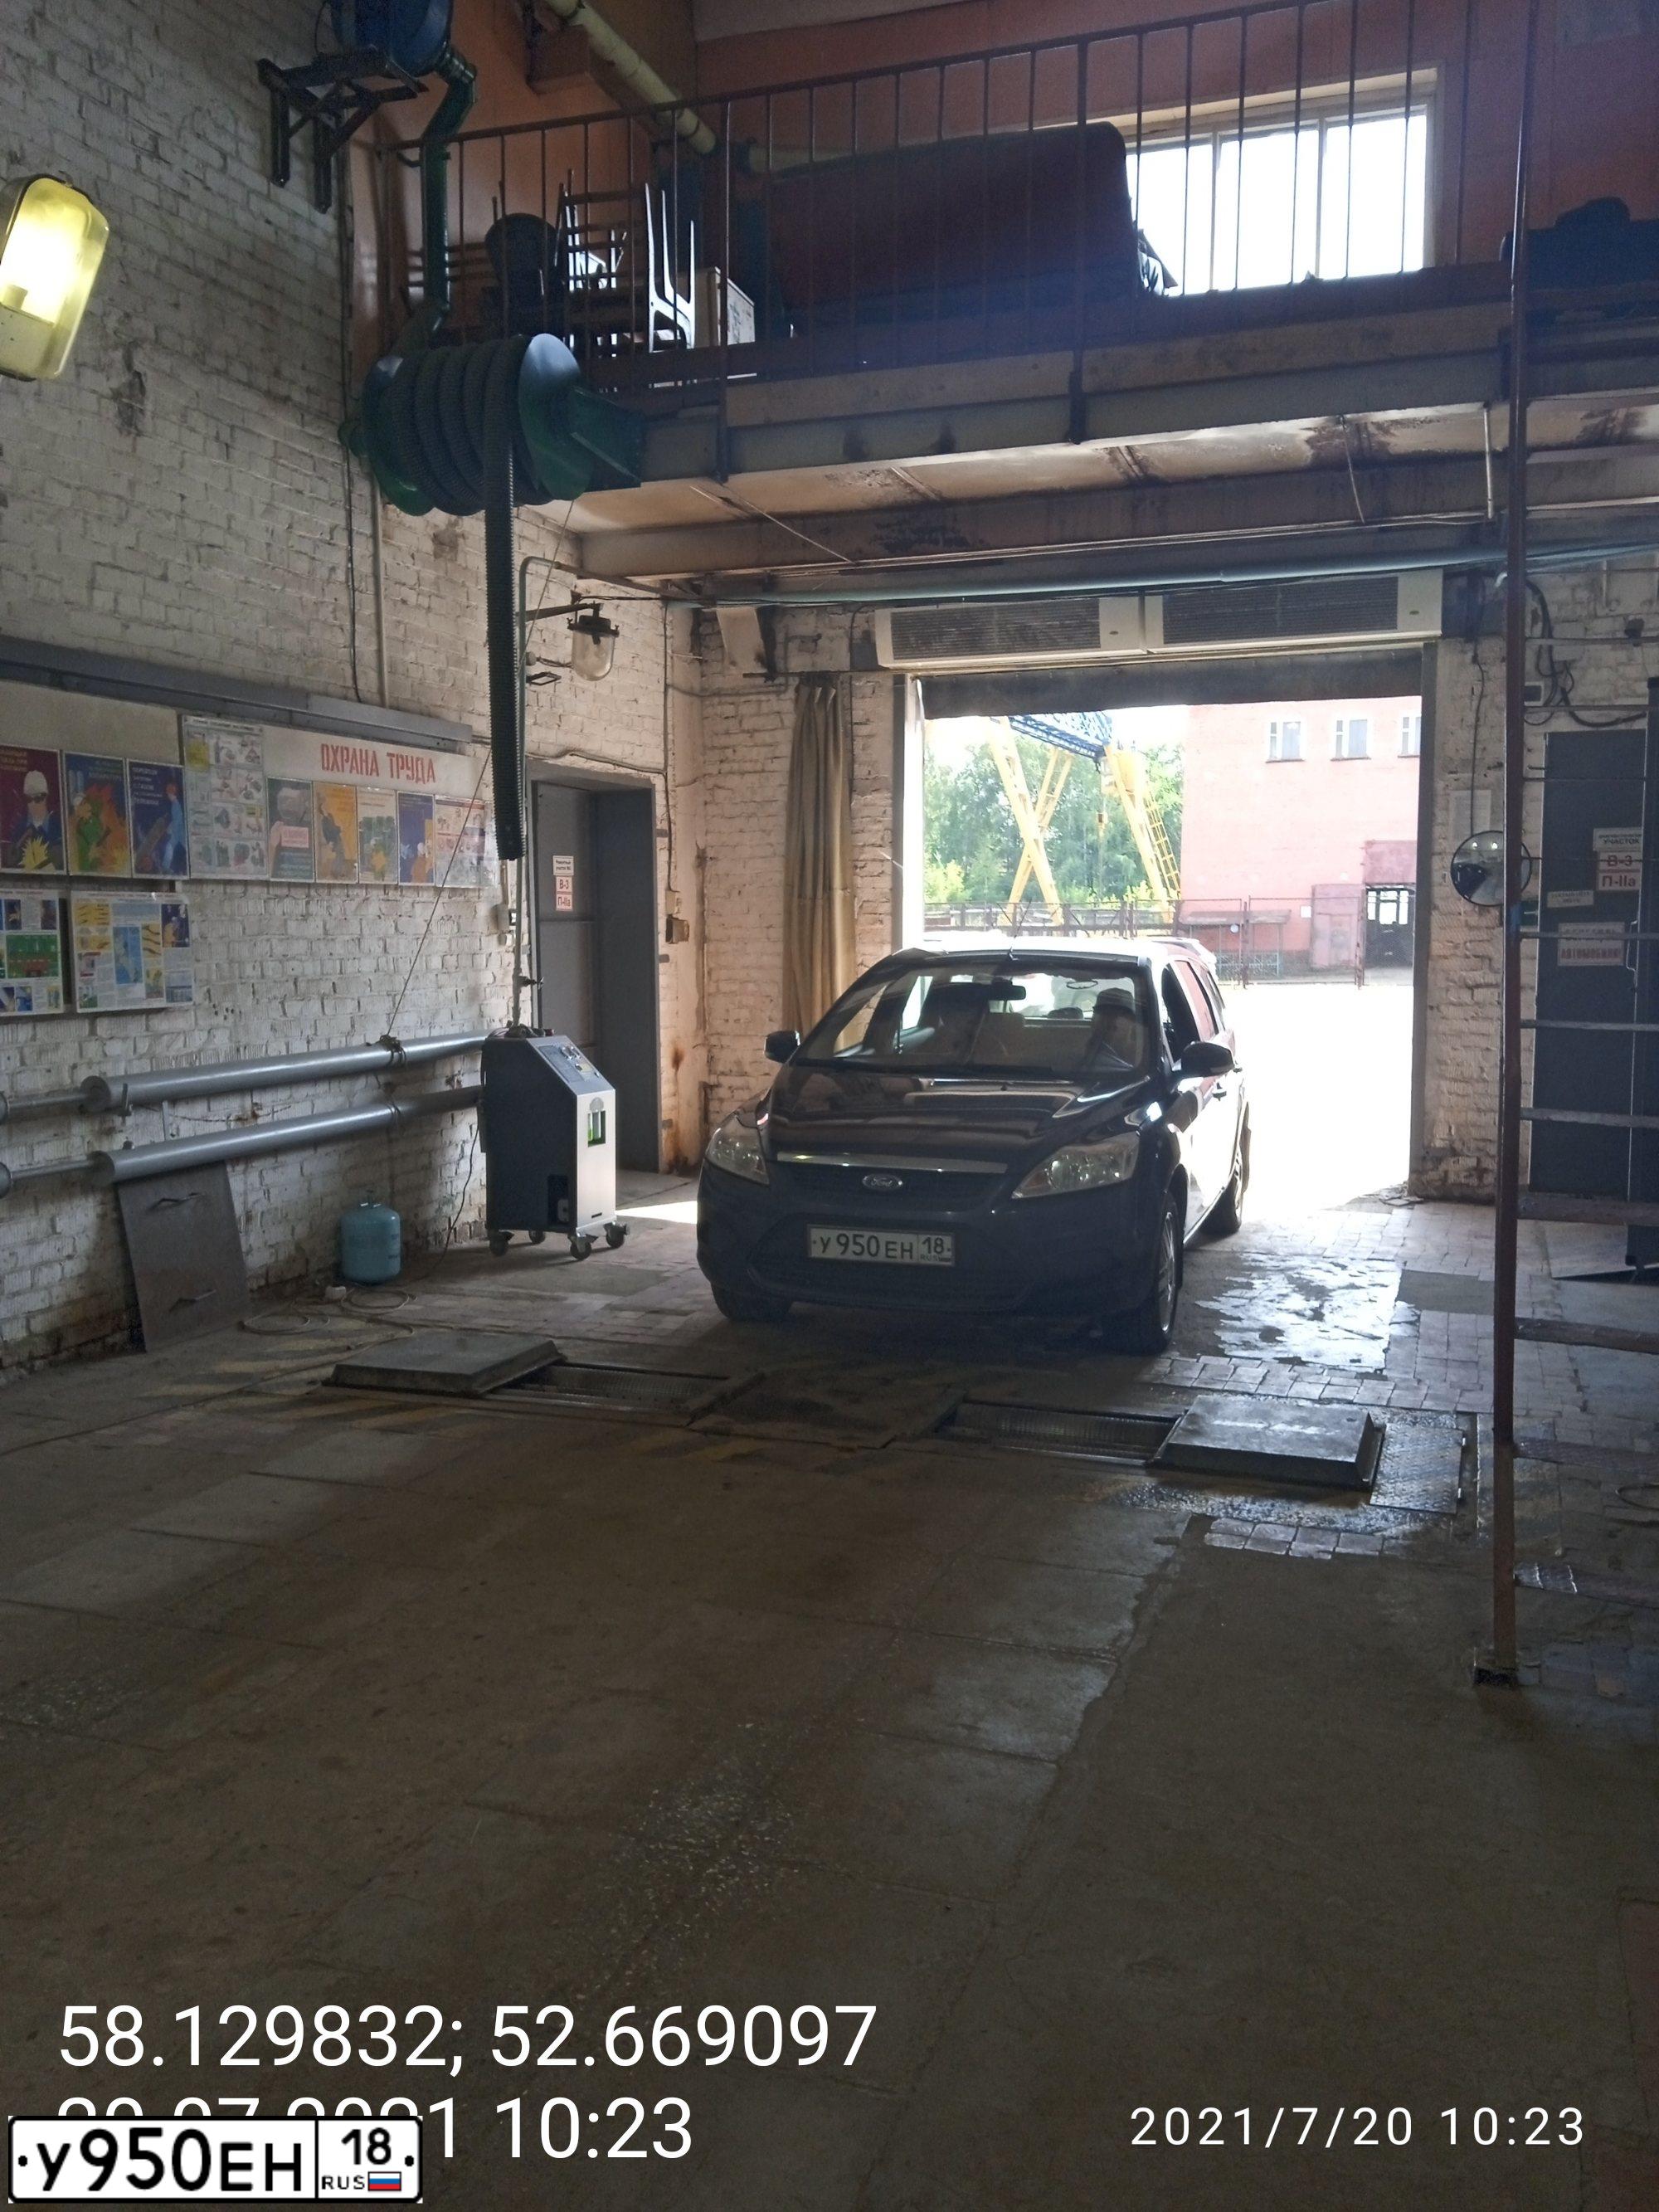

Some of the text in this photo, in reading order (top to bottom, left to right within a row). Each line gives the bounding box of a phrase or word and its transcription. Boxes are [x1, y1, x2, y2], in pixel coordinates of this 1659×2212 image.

[321, 743, 435, 785] ОХРАНА ТРУДА
[1608, 855, 1633, 867] В-3
[871, 1178, 893, 1187] Ford
[820, 1233, 944, 1260] У950ЕН 18
